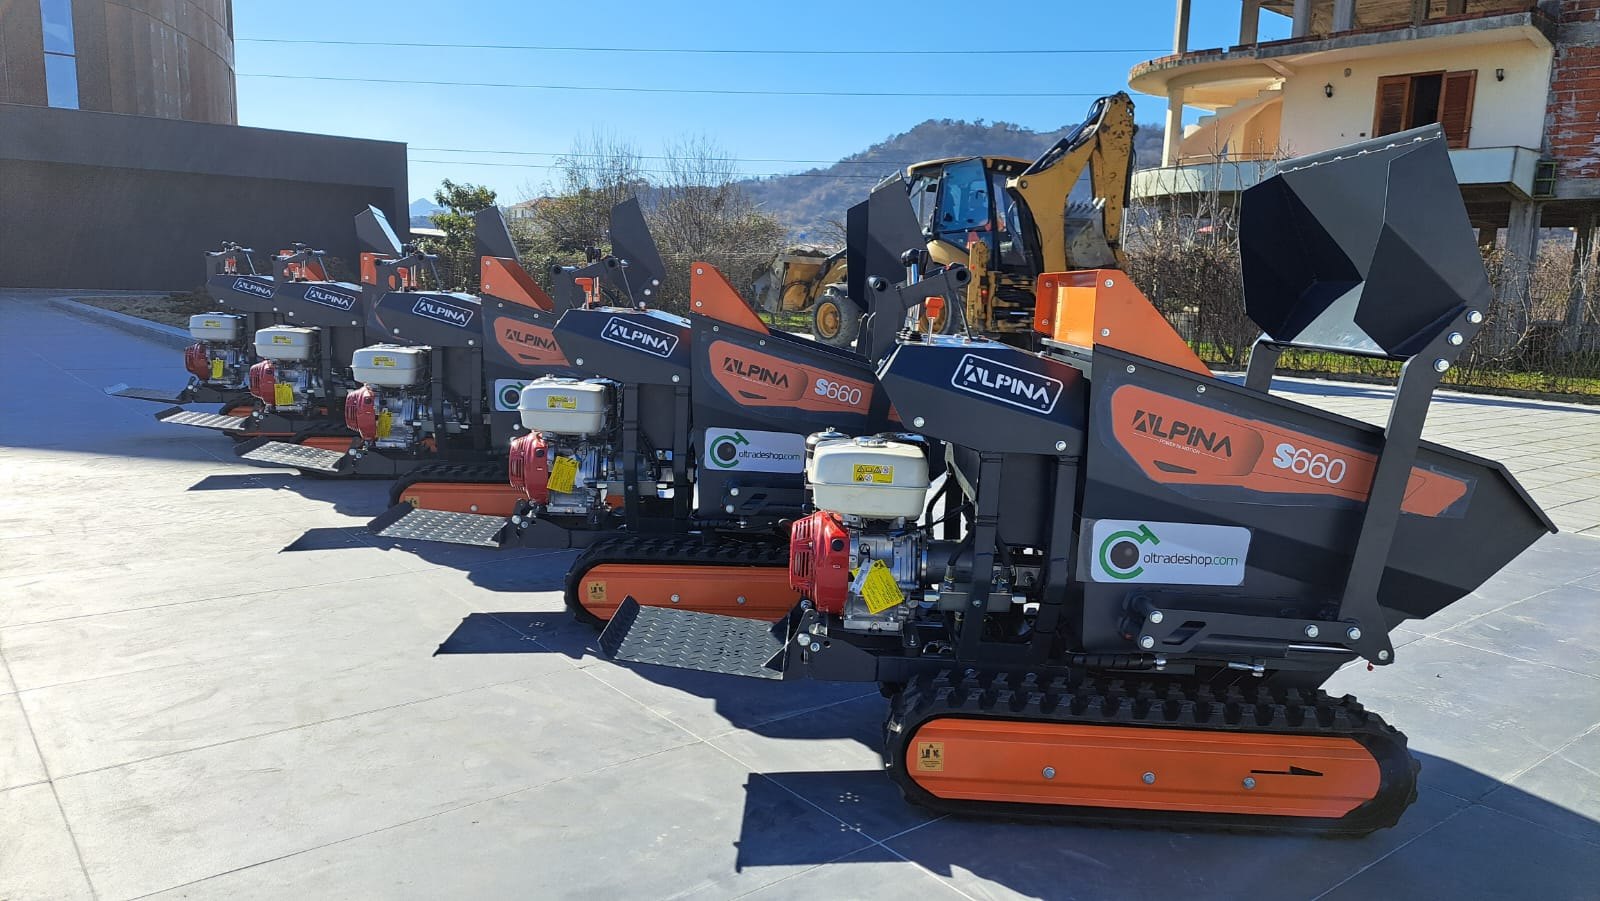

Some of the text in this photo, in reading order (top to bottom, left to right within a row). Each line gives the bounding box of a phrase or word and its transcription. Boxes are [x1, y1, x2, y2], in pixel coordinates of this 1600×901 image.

[236, 280, 272, 296] ALPINA
[309, 289, 350, 307] ALPINA
[419, 301, 466, 323] ALPINA
[505, 328, 557, 352] ALPINA
[609, 323, 669, 352] ALPINA
[723, 356, 789, 388] ALPINA
[963, 363, 1050, 404] ALPINA
[815, 378, 862, 405] S660
[1131, 409, 1232, 458] ALPINA
[1272, 443, 1347, 484] S660
